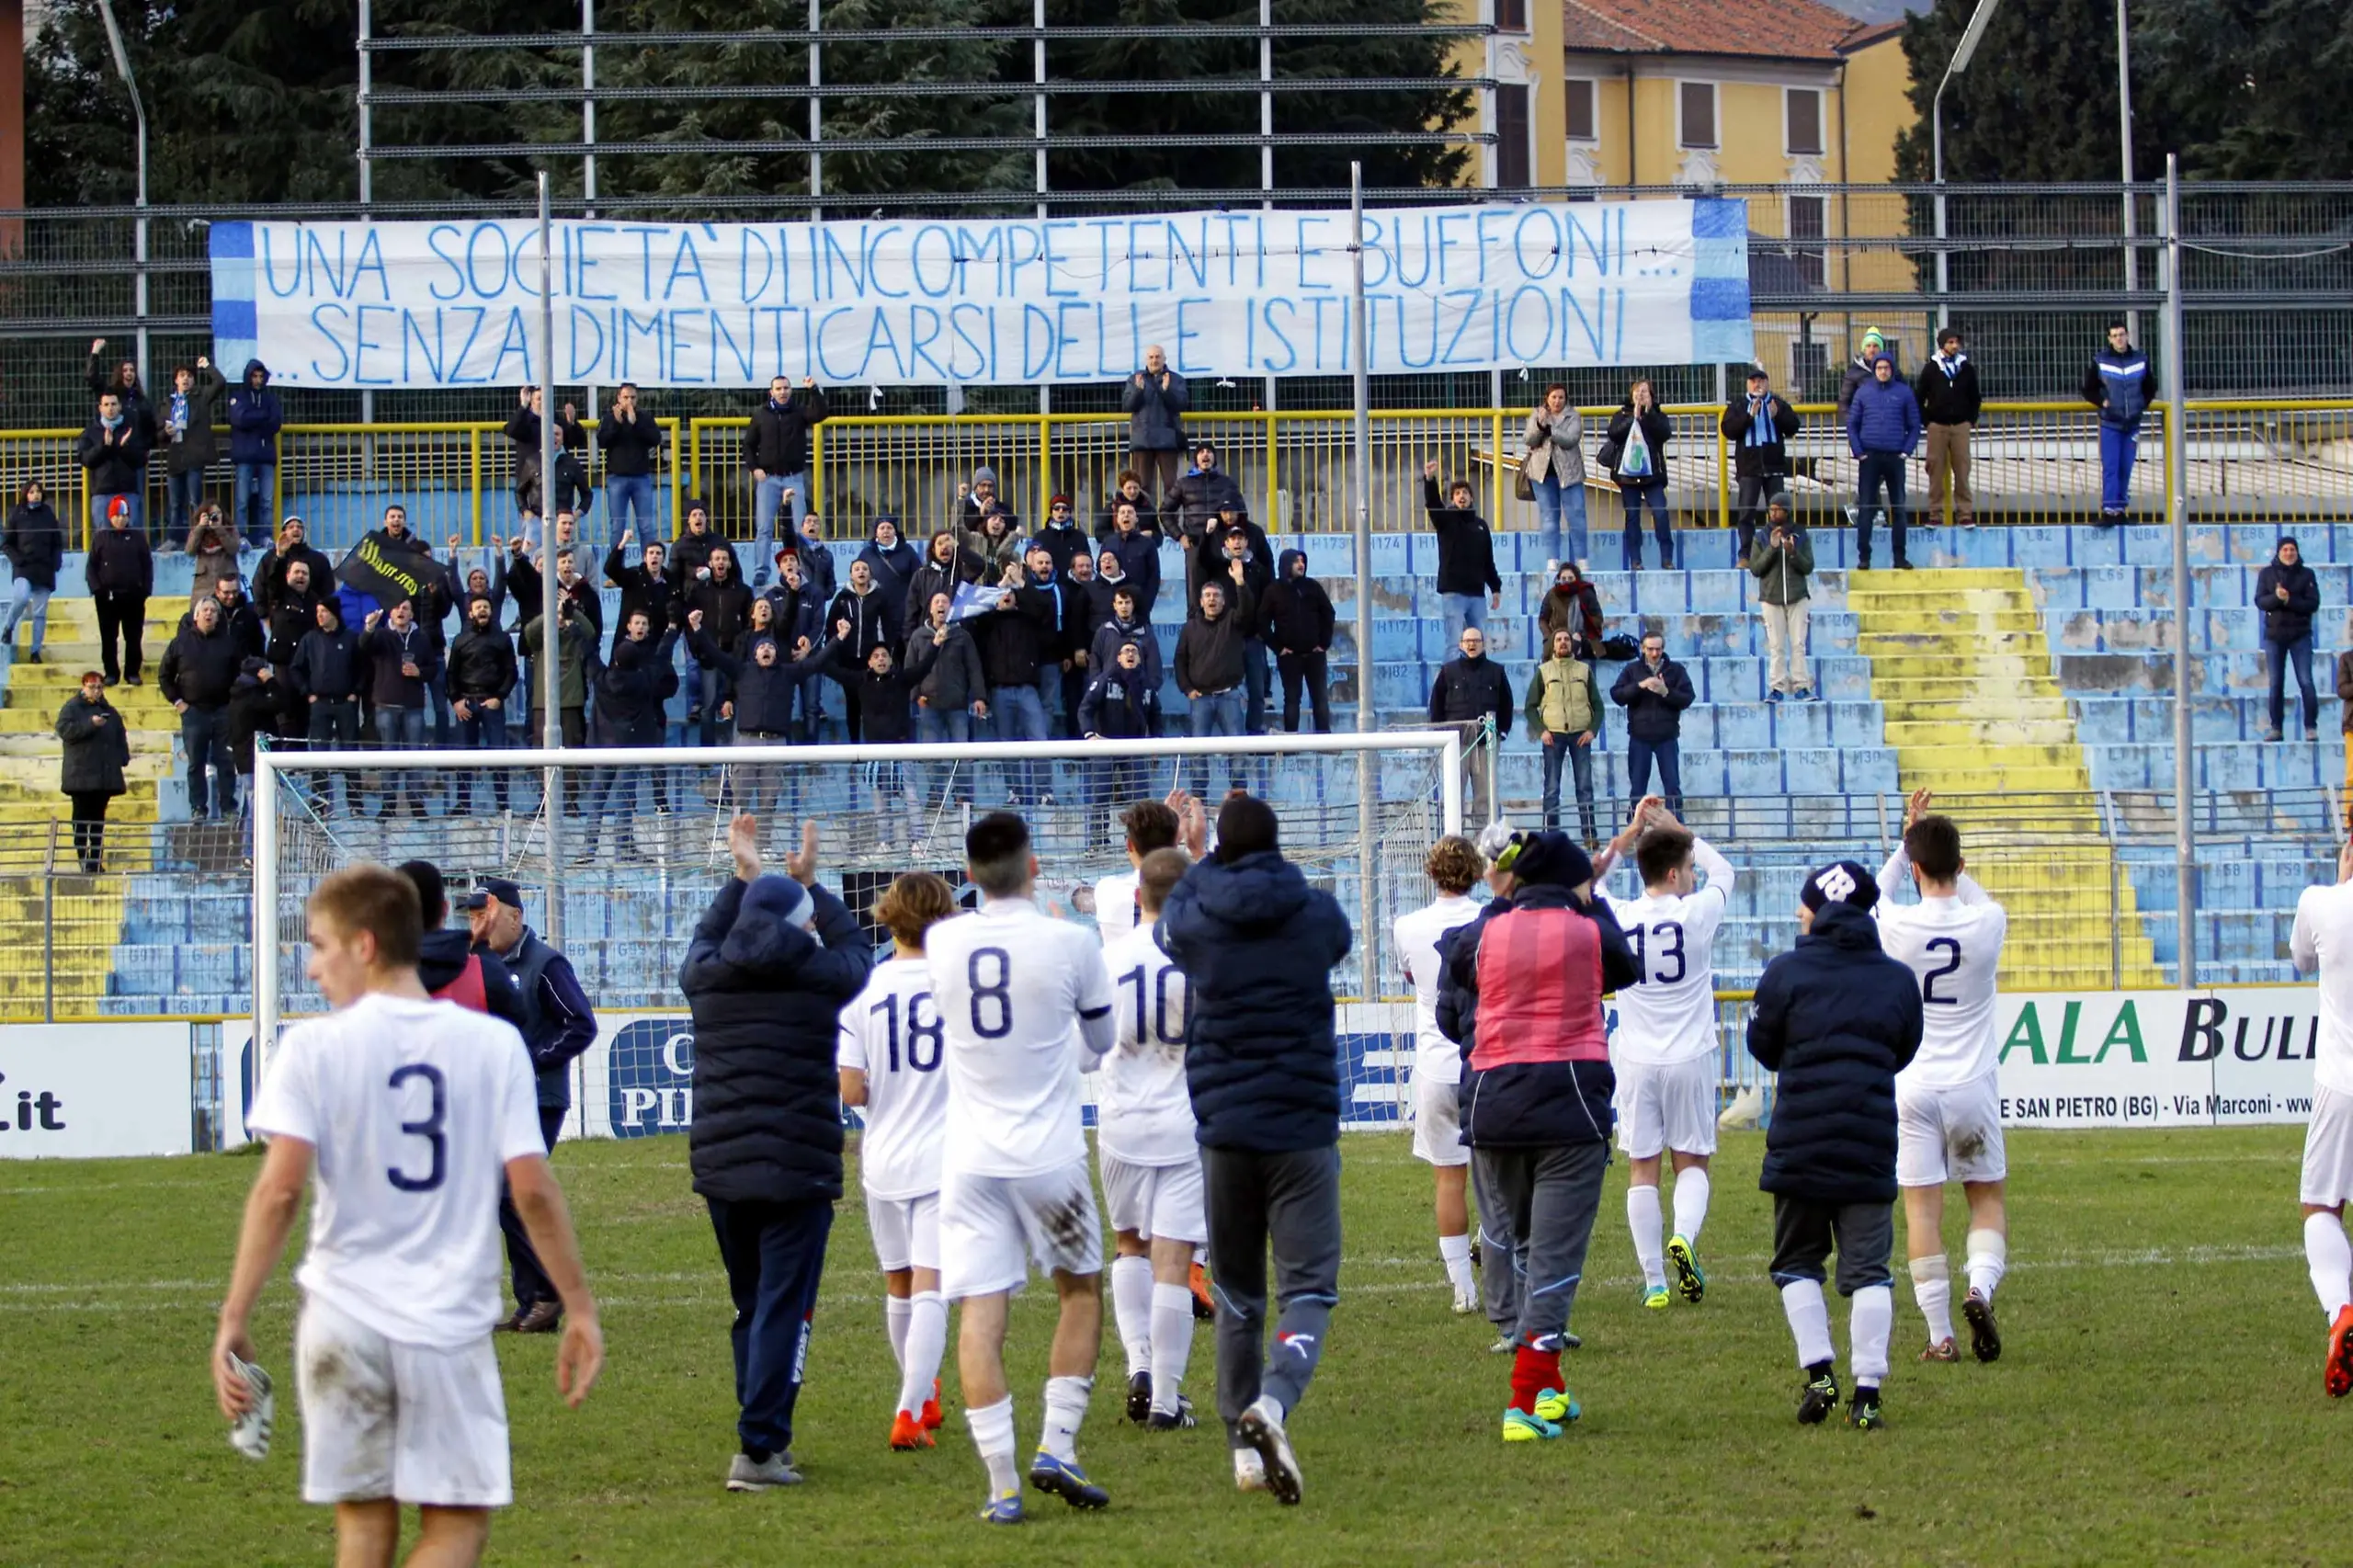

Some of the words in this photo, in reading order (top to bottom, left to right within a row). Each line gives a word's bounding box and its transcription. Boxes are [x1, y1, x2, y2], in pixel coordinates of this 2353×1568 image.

[262, 226, 390, 301] UNA
[740, 226, 790, 304] DI
[809, 213, 1265, 300] INCOMPETENTI
[1298, 217, 1332, 289] E
[570, 302, 997, 383] DIMENTICARSI
[1023, 299, 1214, 380] DELLE
[1246, 285, 1626, 370] ISTITUZIONI
[968, 946, 1012, 1040] 8
[1624, 921, 1686, 984] 13
[1923, 937, 1962, 1005] 2
[870, 991, 945, 1074] 18
[1117, 963, 1188, 1045] 10
[387, 1062, 448, 1192] 3
[2015, 1096, 2050, 1119] SAN
[2055, 1096, 2118, 1119] PIETRO
[2122, 1095, 2158, 1121] (BG)
[2173, 1095, 2200, 1116] Via
[2210, 1094, 2272, 1116] Marconi
